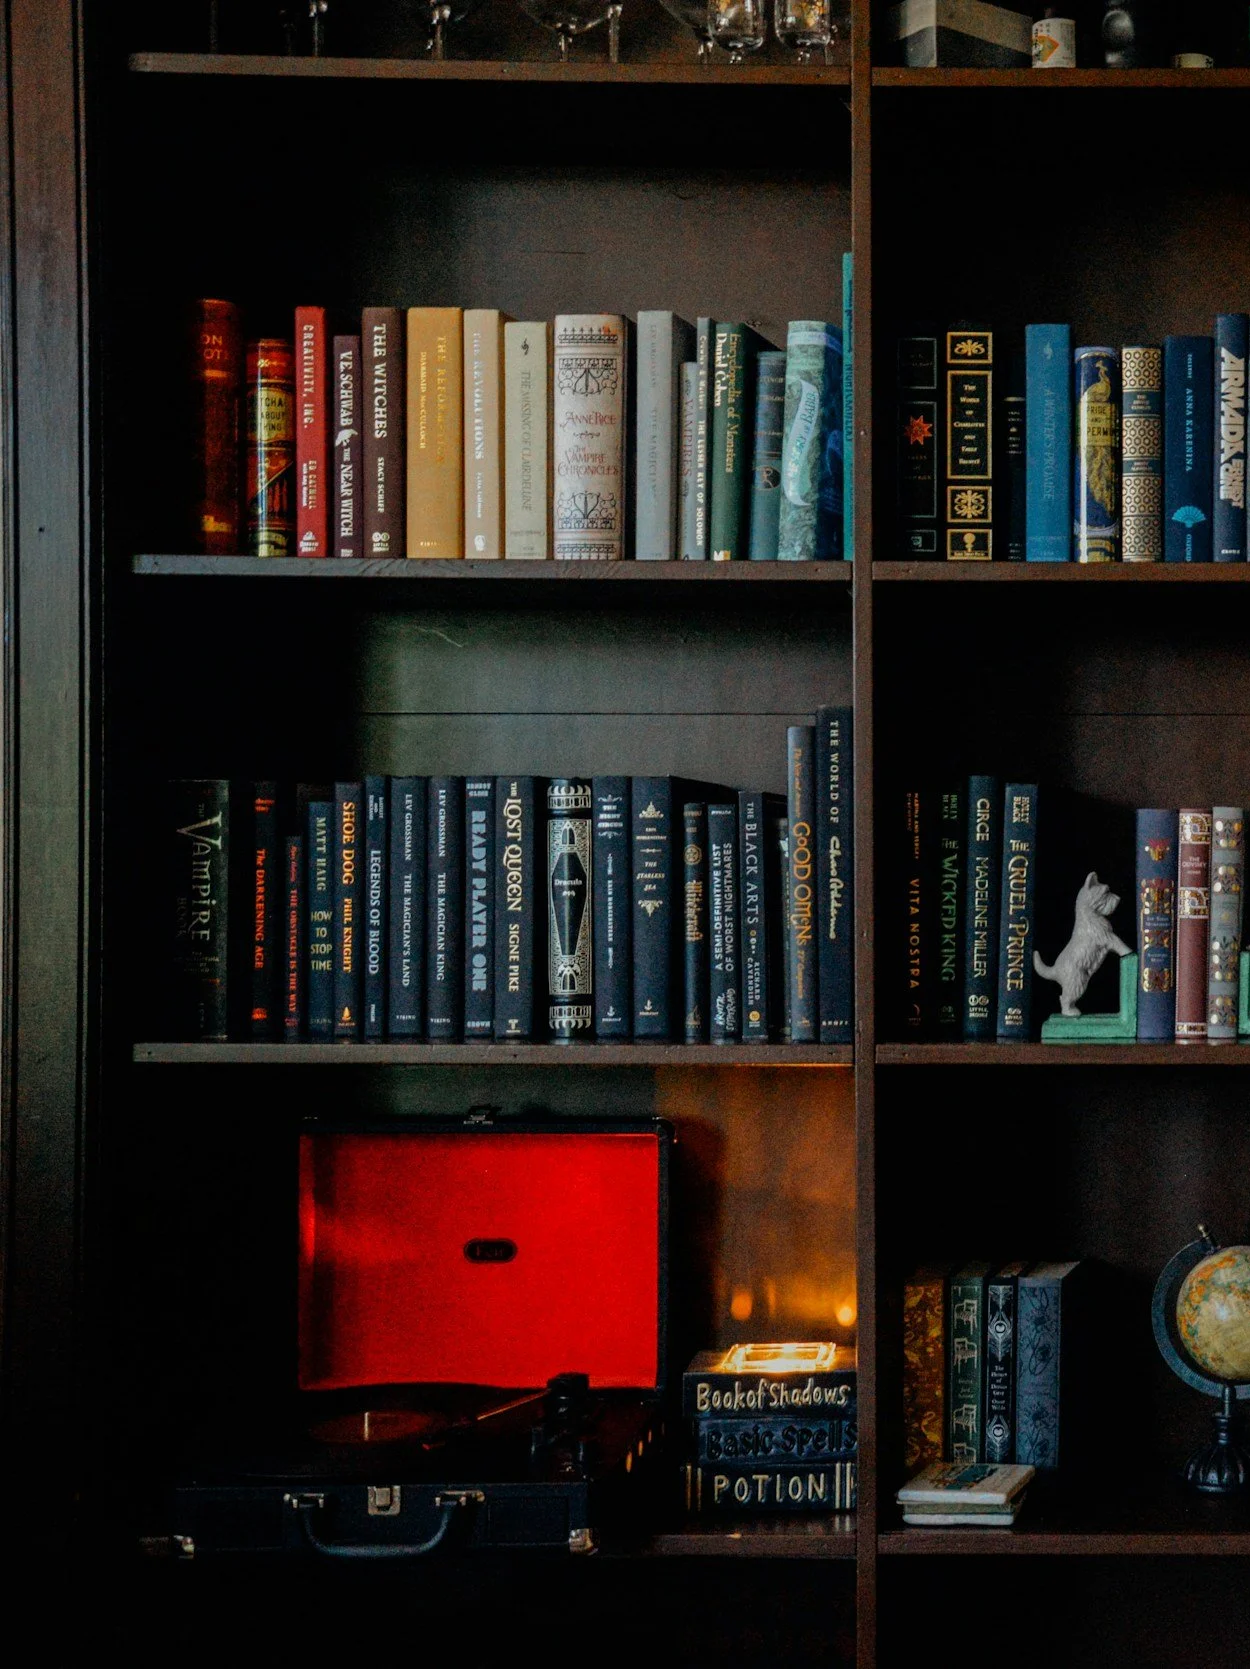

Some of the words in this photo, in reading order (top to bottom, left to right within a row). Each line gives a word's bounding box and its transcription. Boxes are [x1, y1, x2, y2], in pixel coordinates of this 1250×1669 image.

[373, 323, 387, 357] THE
[715, 333, 728, 367] Daniel
[303, 325, 315, 398] CREATIVITY,
[727, 333, 742, 403] Encyclopedia
[339, 374, 353, 426] SCHWAB
[373, 362, 388, 439] WITCHES
[714, 371, 727, 408] Cohen
[1185, 388, 1194, 416] ANNA
[1221, 347, 1246, 465] ARMADA
[303, 403, 315, 429] INC.
[726, 406, 738, 418] of
[343, 448, 351, 462] THE
[682, 399, 693, 477] VAMPIRES
[724, 421, 739, 474] Monsters
[1185, 419, 1194, 472] KARENINA
[340, 464, 353, 497] NEAR
[377, 457, 386, 481] STACY
[558, 462, 620, 478] CHRONICLES
[1043, 451, 1056, 500] PROMISE
[696, 491, 705, 505] OF
[340, 499, 353, 537] WITCH
[829, 720, 840, 747] THE
[509, 781, 519, 798] THE
[828, 753, 840, 801] WORLD
[404, 794, 413, 809] LEV
[438, 789, 447, 806] LEV
[746, 801, 755, 820] THE
[829, 806, 840, 823] OF
[1011, 796, 1022, 823] BLACK
[1019, 796, 1030, 824] HOLLY
[315, 817, 328, 851] MATT
[342, 802, 356, 844] SHOE
[403, 812, 413, 861] GROSSMAN
[438, 808, 447, 858] GROSSMAN
[503, 798, 523, 841] LOST
[976, 798, 990, 842] CIRCE
[255, 848, 269, 867] The
[471, 810, 487, 872] READY
[713, 844, 723, 867] LIST
[744, 823, 757, 875] BLACK
[792, 821, 812, 881] GOOD
[1010, 840, 1030, 852] THE
[315, 858, 328, 892] HAIG
[341, 849, 356, 884] DOG
[368, 849, 382, 907] LEGENDS
[502, 844, 523, 912] QUEEN
[644, 860, 658, 868] THE
[723, 842, 734, 913] NIGHTMARES
[403, 873, 413, 893] THE
[437, 872, 447, 894] THE
[909, 877, 920, 916] VITA
[940, 853, 960, 928] WICKED
[974, 857, 989, 928] MADELINE
[1008, 854, 1030, 915] CRUEL
[253, 870, 268, 942] DARKENING
[310, 910, 332, 922] HOW
[342, 898, 353, 924] PHIL
[368, 909, 381, 926] OF
[471, 877, 487, 948] PLAYER
[712, 870, 723, 960] SEMI-DEFINITIVE
[744, 881, 757, 924] ARTS
[790, 883, 813, 946] OMENS
[315, 926, 328, 938] TO
[402, 897, 412, 956] MAGICIAN'S
[436, 898, 446, 951] MAGICIAN
[508, 924, 520, 961] SIGNE
[724, 915, 733, 953] WORST
[253, 946, 266, 970] AGE
[310, 943, 332, 954] STOP
[310, 959, 332, 971] TIME
[341, 927, 353, 974] KNIGHT
[367, 930, 381, 976] BLOOD
[713, 963, 723, 971] A
[724, 955, 733, 972] OF
[908, 923, 920, 989] NOSTRA
[940, 933, 958, 983] KING
[973, 931, 987, 978] MILLER
[1006, 916, 1030, 992] PRINCE
[401, 959, 412, 988] LAND
[436, 954, 446, 982] KING
[471, 952, 487, 992] ONE
[508, 964, 520, 993] PIKE
[746, 956, 754, 1006] CAVENDISH
[769, 1377, 852, 1408] Shadows
[705, 1423, 775, 1461] Basic
[780, 1418, 858, 1458] Spells
[713, 1472, 827, 1504] POTION
